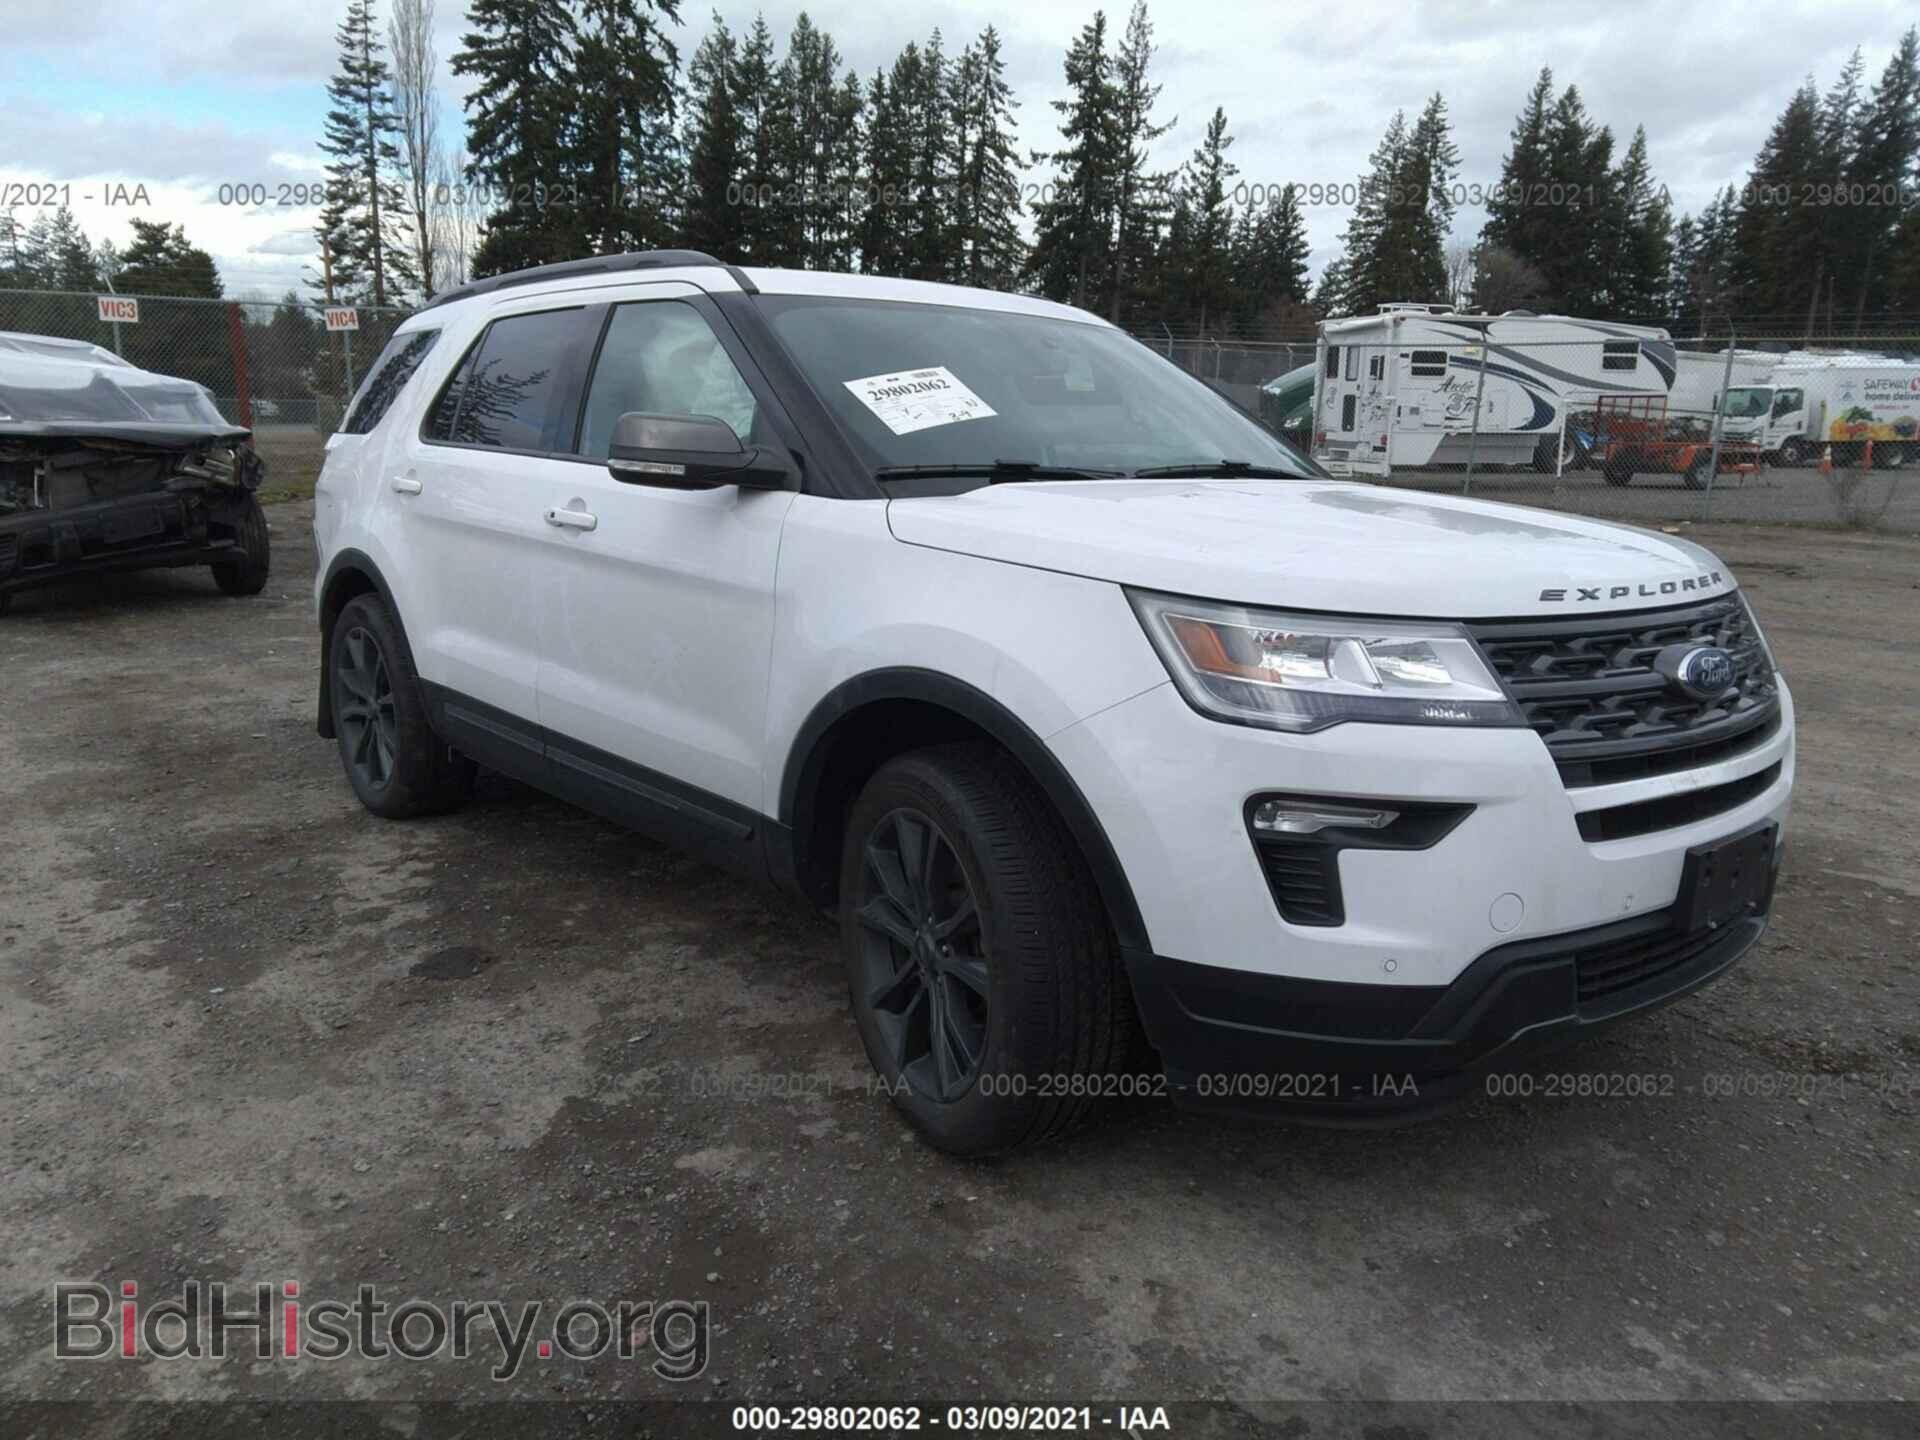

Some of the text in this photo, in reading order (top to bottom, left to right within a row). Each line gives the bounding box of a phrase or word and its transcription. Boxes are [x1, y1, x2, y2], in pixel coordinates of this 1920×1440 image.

[101, 301, 137, 319] VIC3
[326, 311, 357, 328] VIC4
[867, 378, 951, 402] 29802062
[1539, 572, 1722, 602] EXPLORER
[1701, 656, 1730, 682] Ford
